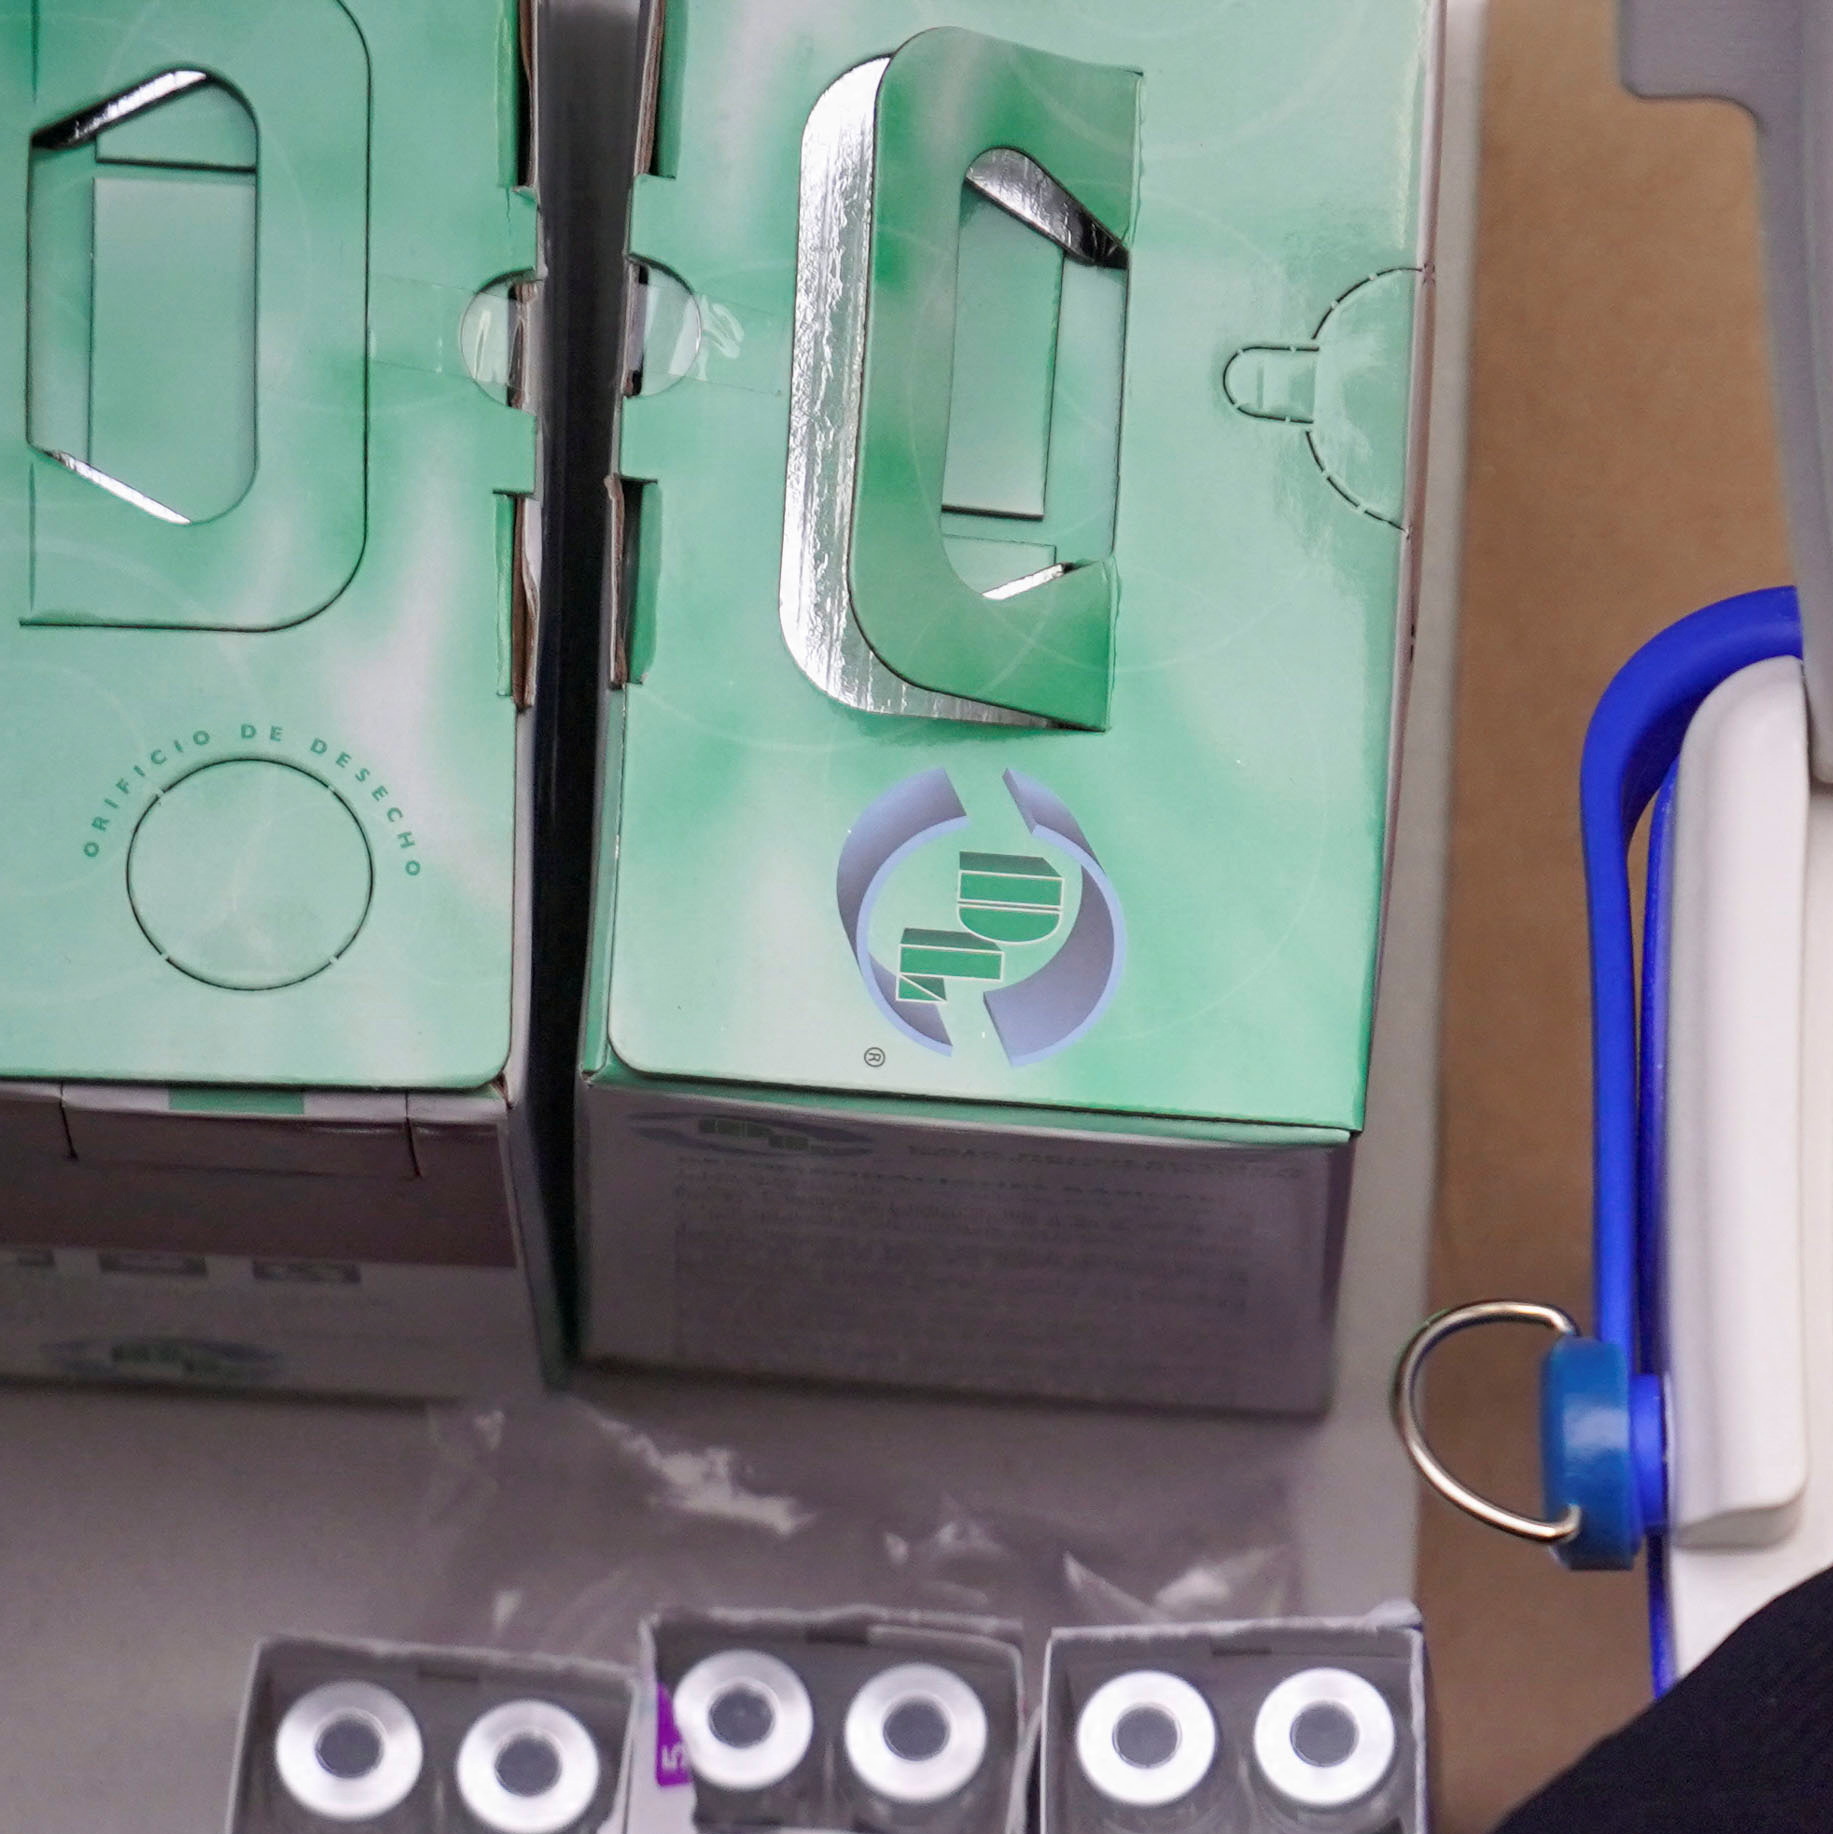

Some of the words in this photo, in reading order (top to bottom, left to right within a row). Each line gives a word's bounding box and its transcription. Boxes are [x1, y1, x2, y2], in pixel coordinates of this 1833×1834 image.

[83, 729, 210, 858] ORIFICIO
[240, 723, 284, 742] DE
[310, 737, 421, 877] DESECHO
